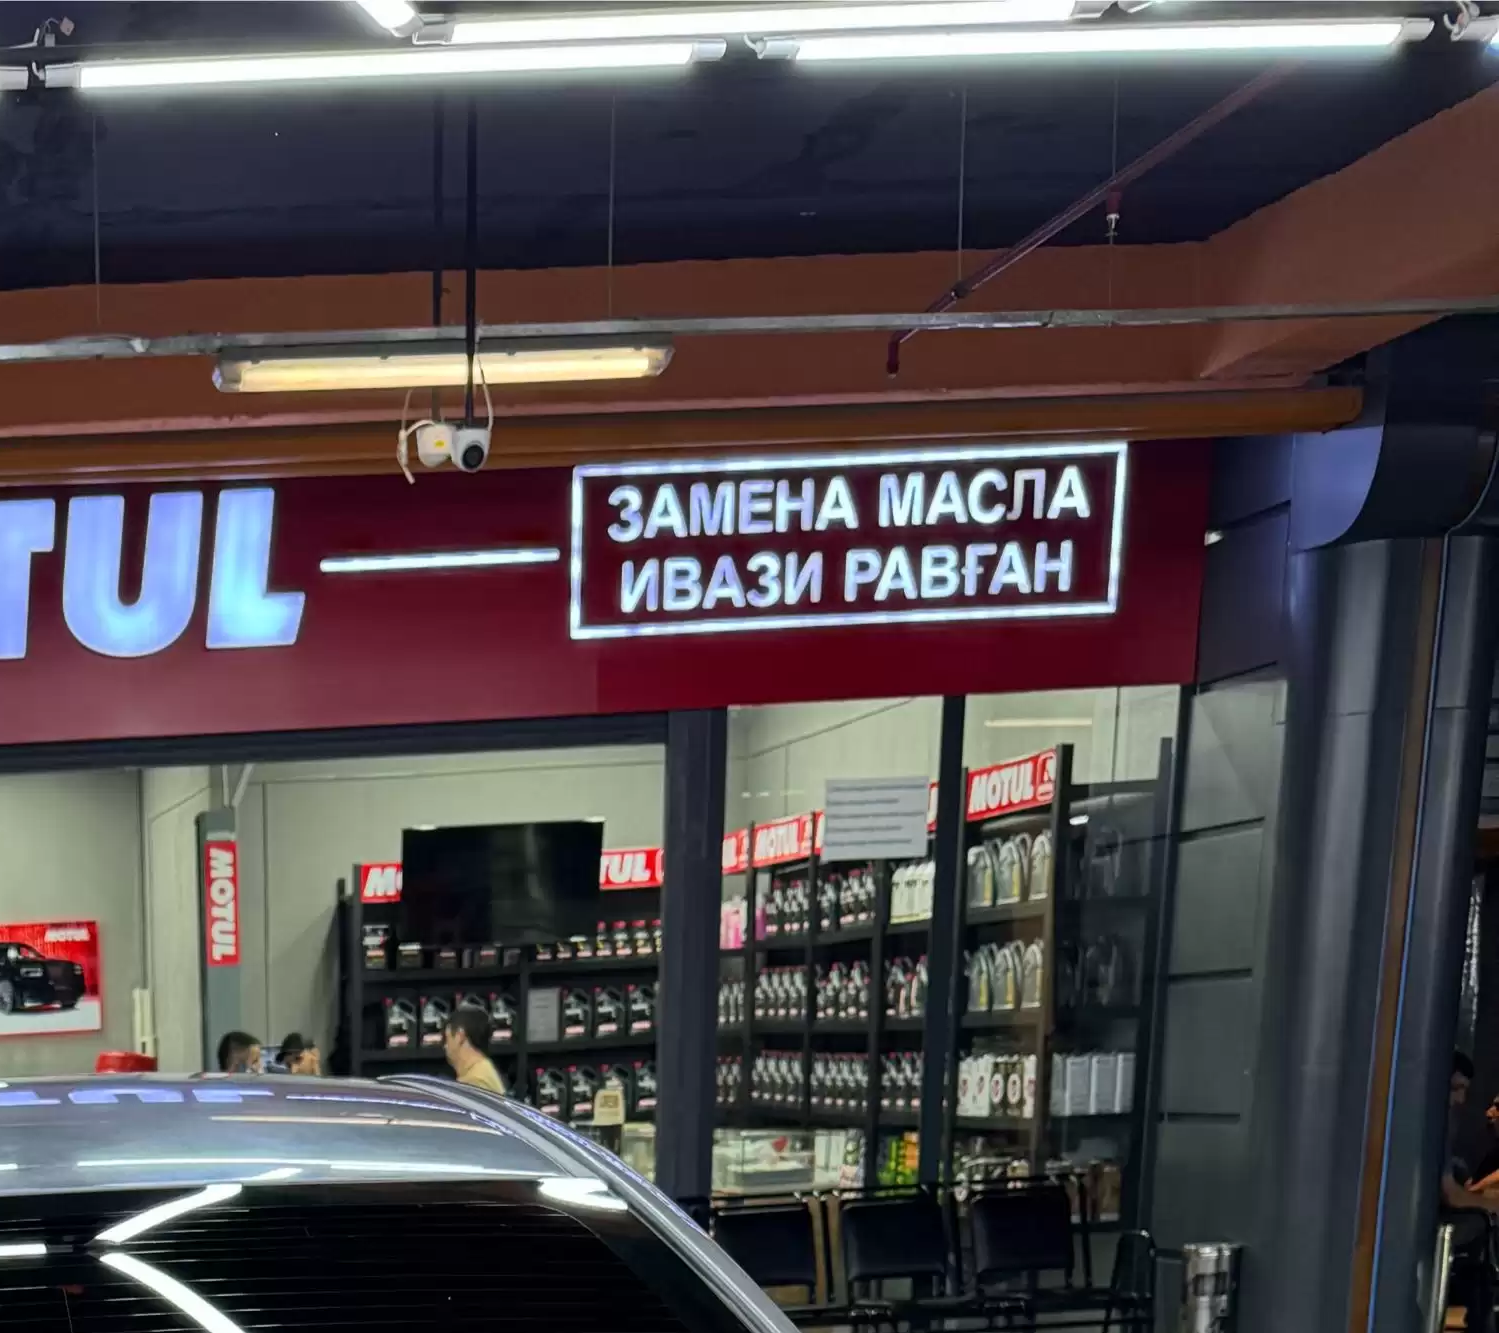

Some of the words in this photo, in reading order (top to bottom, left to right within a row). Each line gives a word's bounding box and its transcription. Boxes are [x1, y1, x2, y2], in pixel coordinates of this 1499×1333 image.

[607, 476, 859, 543] ЗАМЕНА
[878, 465, 1091, 528] МАСЛА
[620, 550, 823, 614] ИВАЗИ
[843, 539, 1074, 603] РАВҒАН
[968, 760, 1034, 814] MOTUL
[754, 820, 799, 861] MOTUL
[208, 847, 236, 961] MOTUL
